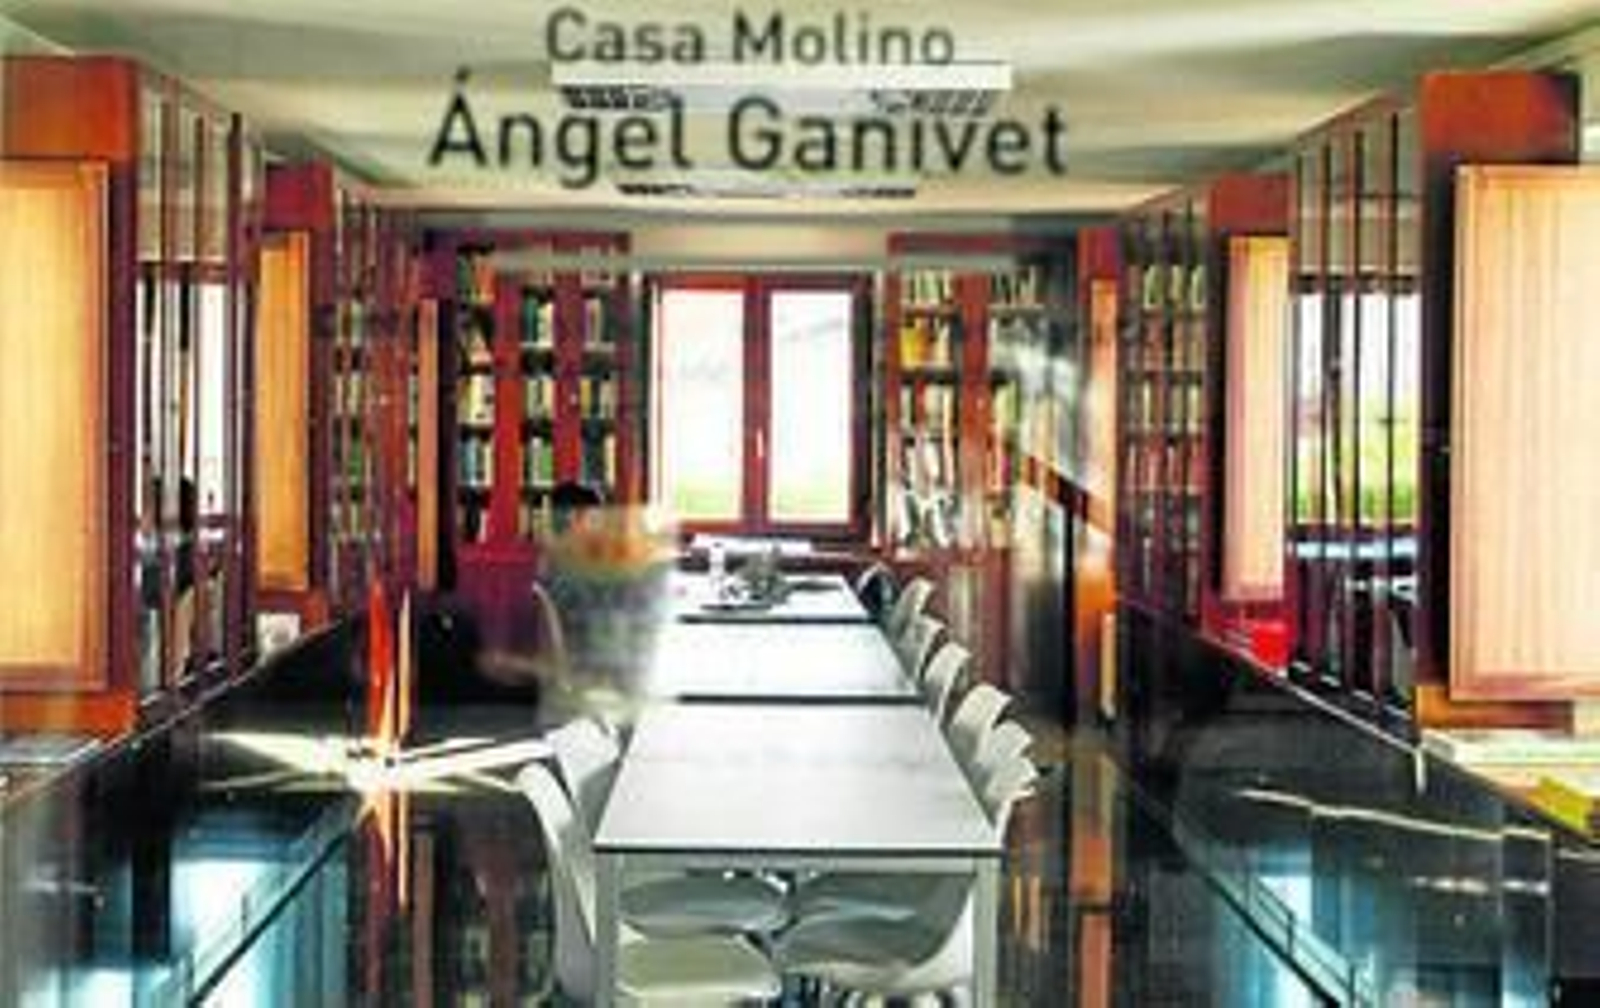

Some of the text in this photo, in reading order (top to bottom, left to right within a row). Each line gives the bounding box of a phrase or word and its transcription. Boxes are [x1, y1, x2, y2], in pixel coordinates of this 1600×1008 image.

[545, 7, 955, 66] Casa Molino
[428, 67, 1068, 189] Ángel Ganivet
